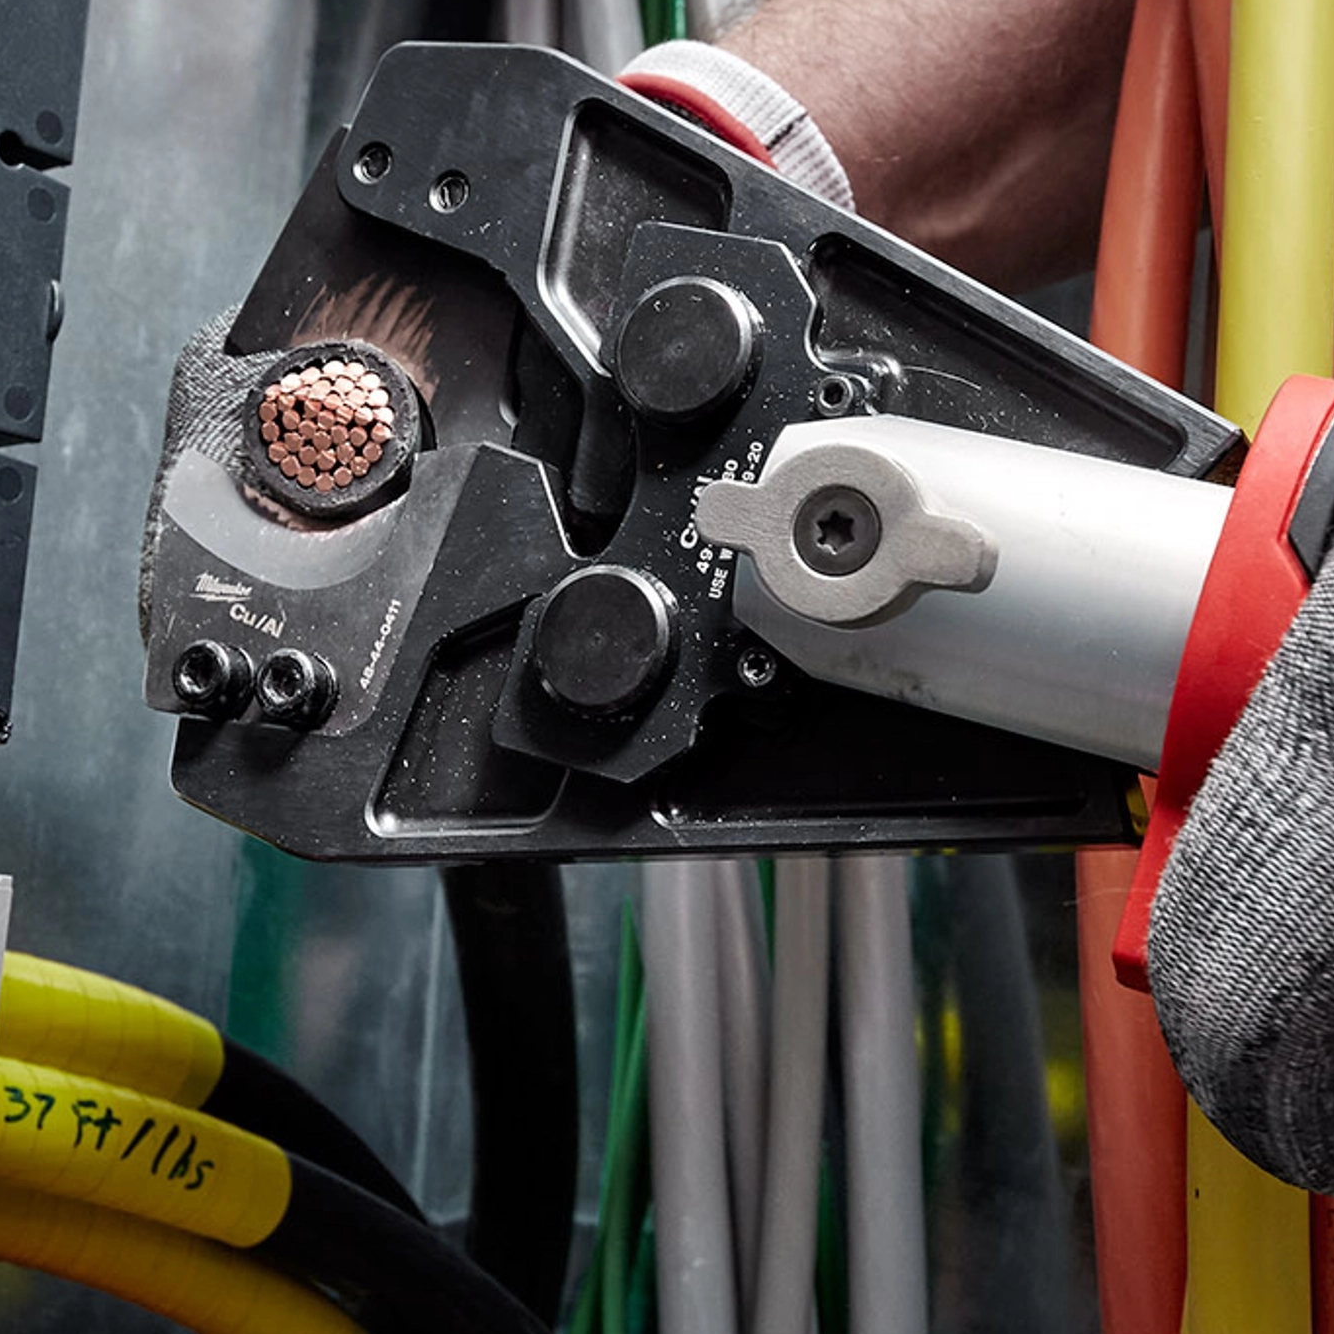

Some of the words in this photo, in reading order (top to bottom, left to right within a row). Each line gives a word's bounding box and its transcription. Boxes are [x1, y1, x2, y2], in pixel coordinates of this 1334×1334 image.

[708, 568, 729, 600] USE
[229, 602, 286, 640] Cu/Al
[3, 1085, 56, 1131] 37
